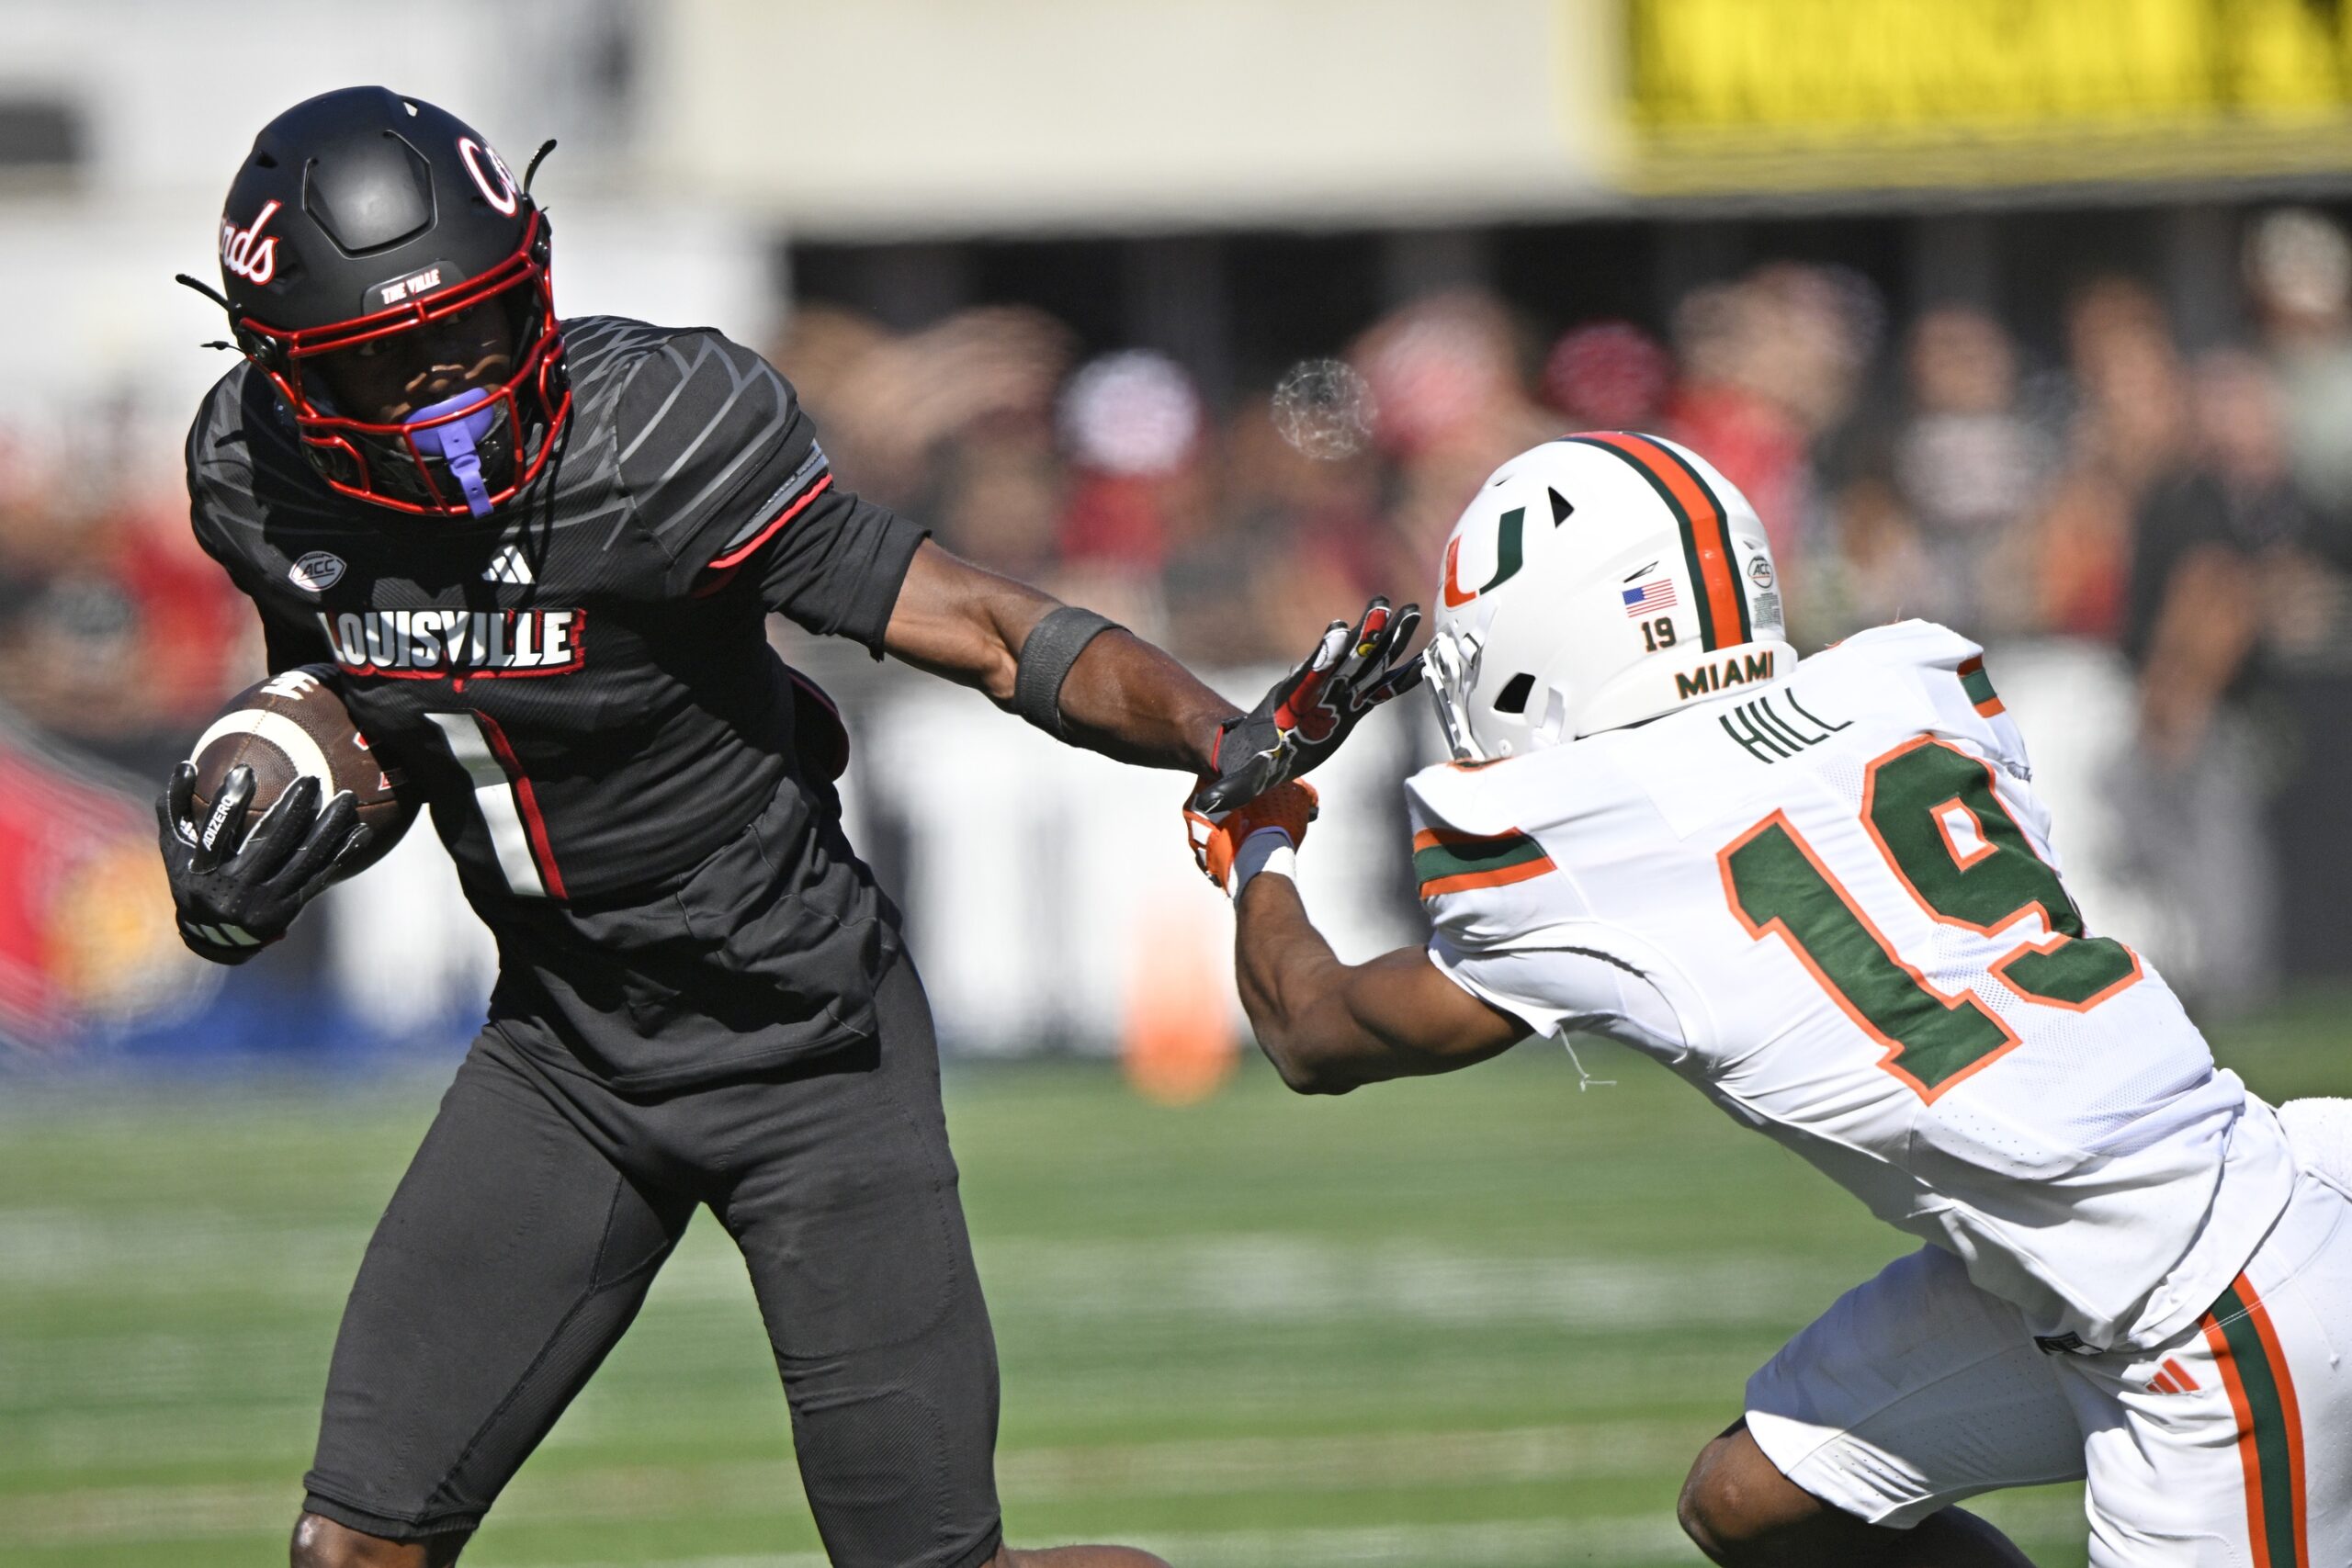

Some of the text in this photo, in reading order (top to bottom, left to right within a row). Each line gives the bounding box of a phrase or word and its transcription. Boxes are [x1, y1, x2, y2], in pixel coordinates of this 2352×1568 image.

[380, 268, 441, 305] THE VILLE
[300, 558, 335, 578] ACC
[1443, 506, 1526, 608] U
[316, 608, 585, 669] LOUISVILLE
[1641, 616, 1677, 652] 19
[1675, 650, 1774, 701] MIAMI
[1718, 687, 1854, 764] HILL
[202, 794, 236, 852] ADIZERO
[1716, 730, 2144, 1107] 19
